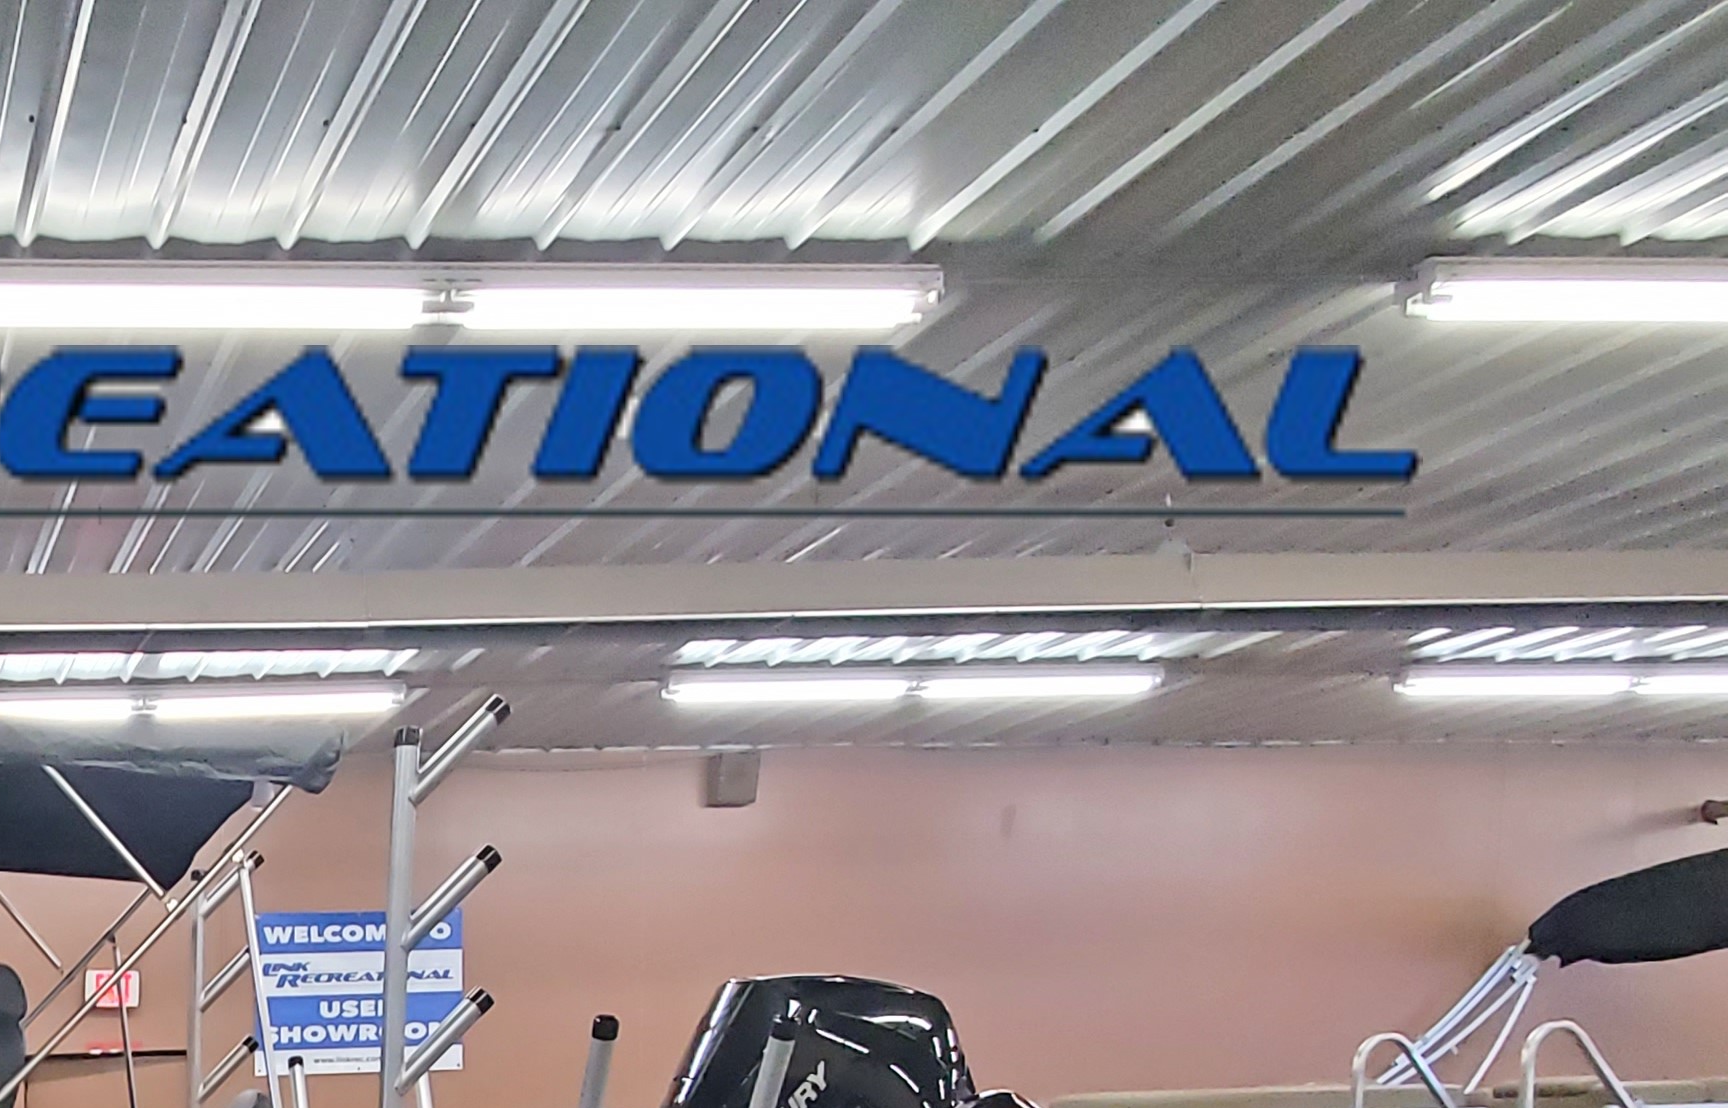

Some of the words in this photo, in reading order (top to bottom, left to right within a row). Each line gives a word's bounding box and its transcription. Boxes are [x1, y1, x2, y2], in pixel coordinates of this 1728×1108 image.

[263, 923, 387, 945] WELCOM
[262, 961, 311, 978] LINK
[275, 968, 454, 989] RECREATNAL
[319, 999, 384, 1019] USE
